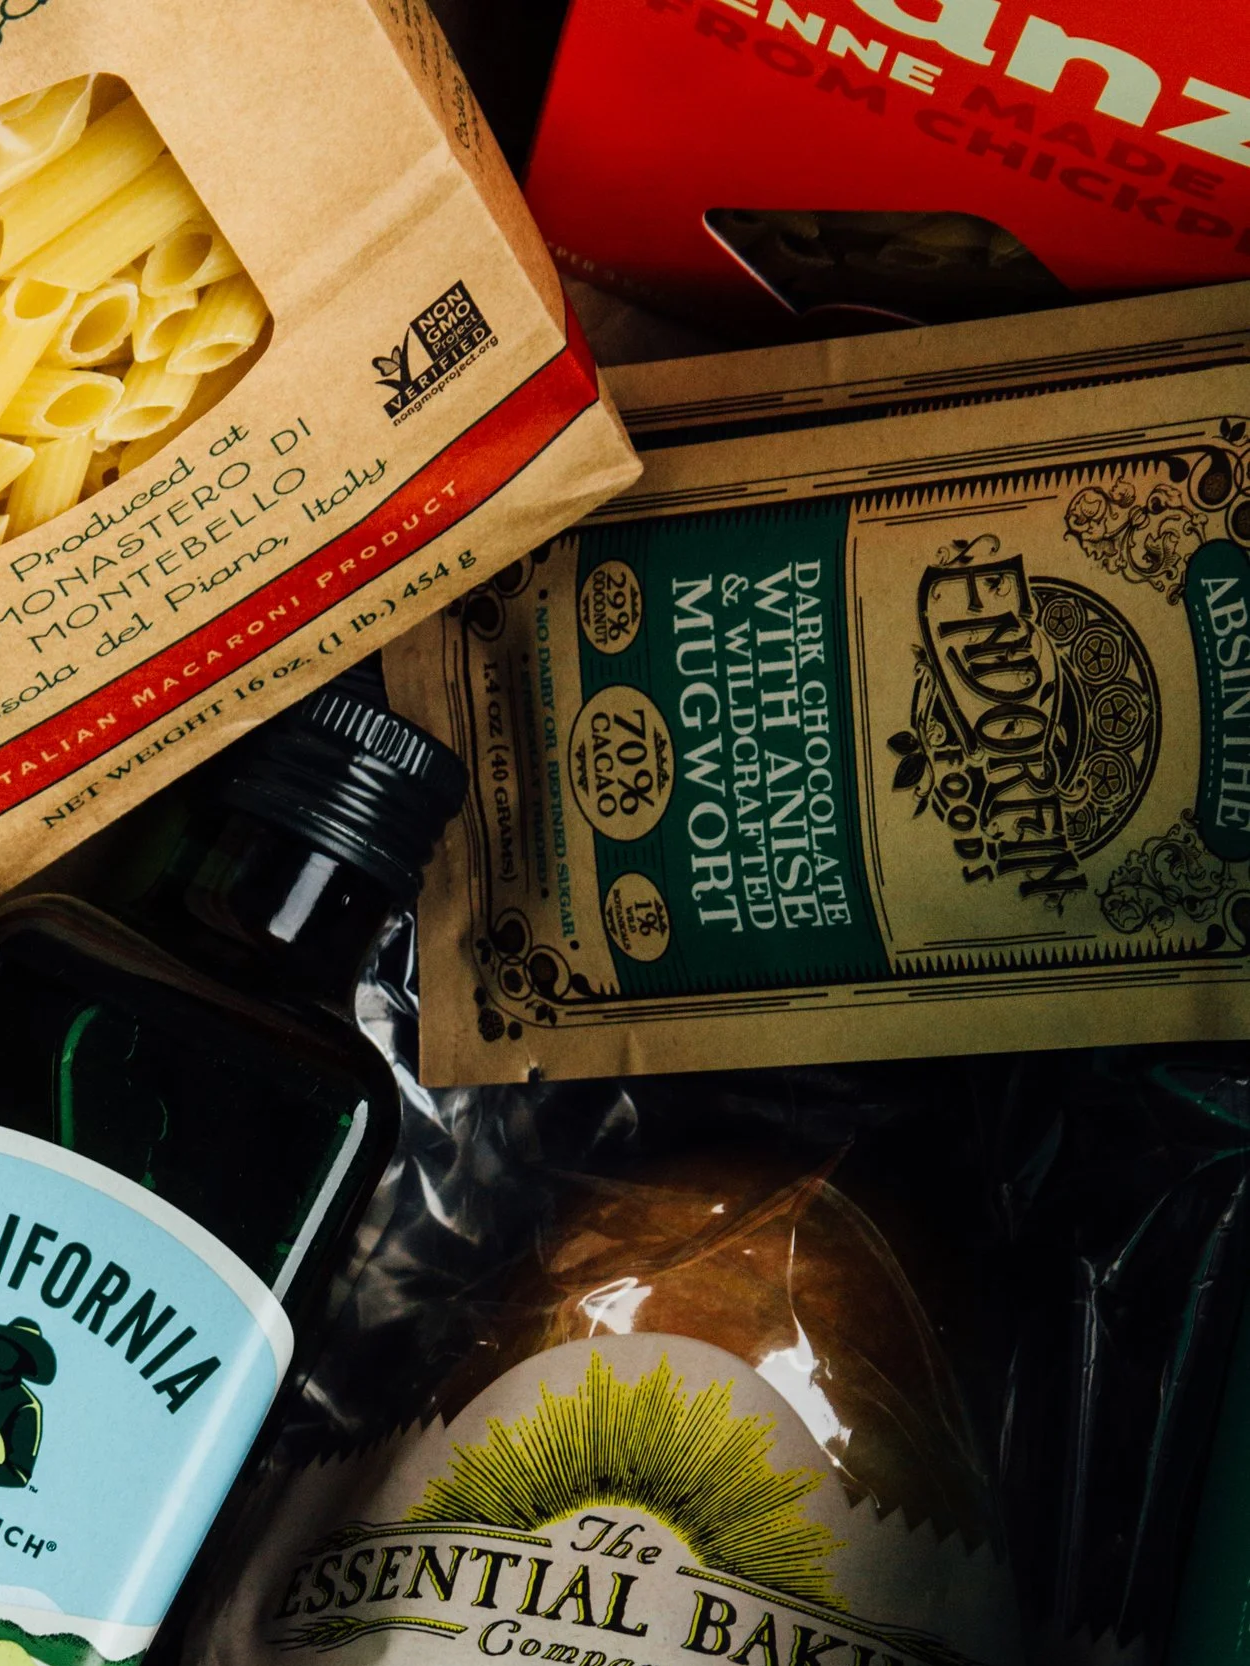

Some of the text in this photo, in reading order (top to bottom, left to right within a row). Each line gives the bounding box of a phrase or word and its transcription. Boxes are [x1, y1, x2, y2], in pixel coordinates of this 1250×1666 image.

[964, 87, 1225, 206] MADE
[391, 328, 489, 409] VERIFIED
[419, 289, 463, 332] NON
[427, 301, 470, 343] GMO
[270, 418, 310, 455] DI
[393, 336, 498, 426] nongmoproject.org
[10, 426, 249, 582] Produced at
[29, 468, 305, 653] MONTEBELLO
[96, 613, 153, 657] del
[165, 537, 288, 612] Piano,
[302, 459, 387, 522] Italy
[132, 596, 299, 707] MACARONI
[317, 480, 455, 588] PRODUCT
[590, 572, 609, 645] COCONUT
[602, 572, 630, 641] 29%
[42, 550, 476, 829] NET WEIGHT 16 oz. (1 lb.) 454 g
[754, 562, 823, 928] WITH ANISE
[796, 560, 851, 925] DARK CHOCOLATE
[918, 553, 1088, 905] ENDORFIN
[482, 662, 518, 882] 1.4 OZ (40 GRAMS)
[591, 712, 617, 818] CACAO
[614, 710, 654, 815] 70%
[673, 574, 743, 932] MUGWORT
[722, 574, 777, 929] & WILDCRAFTED
[277, 1545, 649, 1638] ESSENTIAL
[569, 1514, 662, 1567] The
